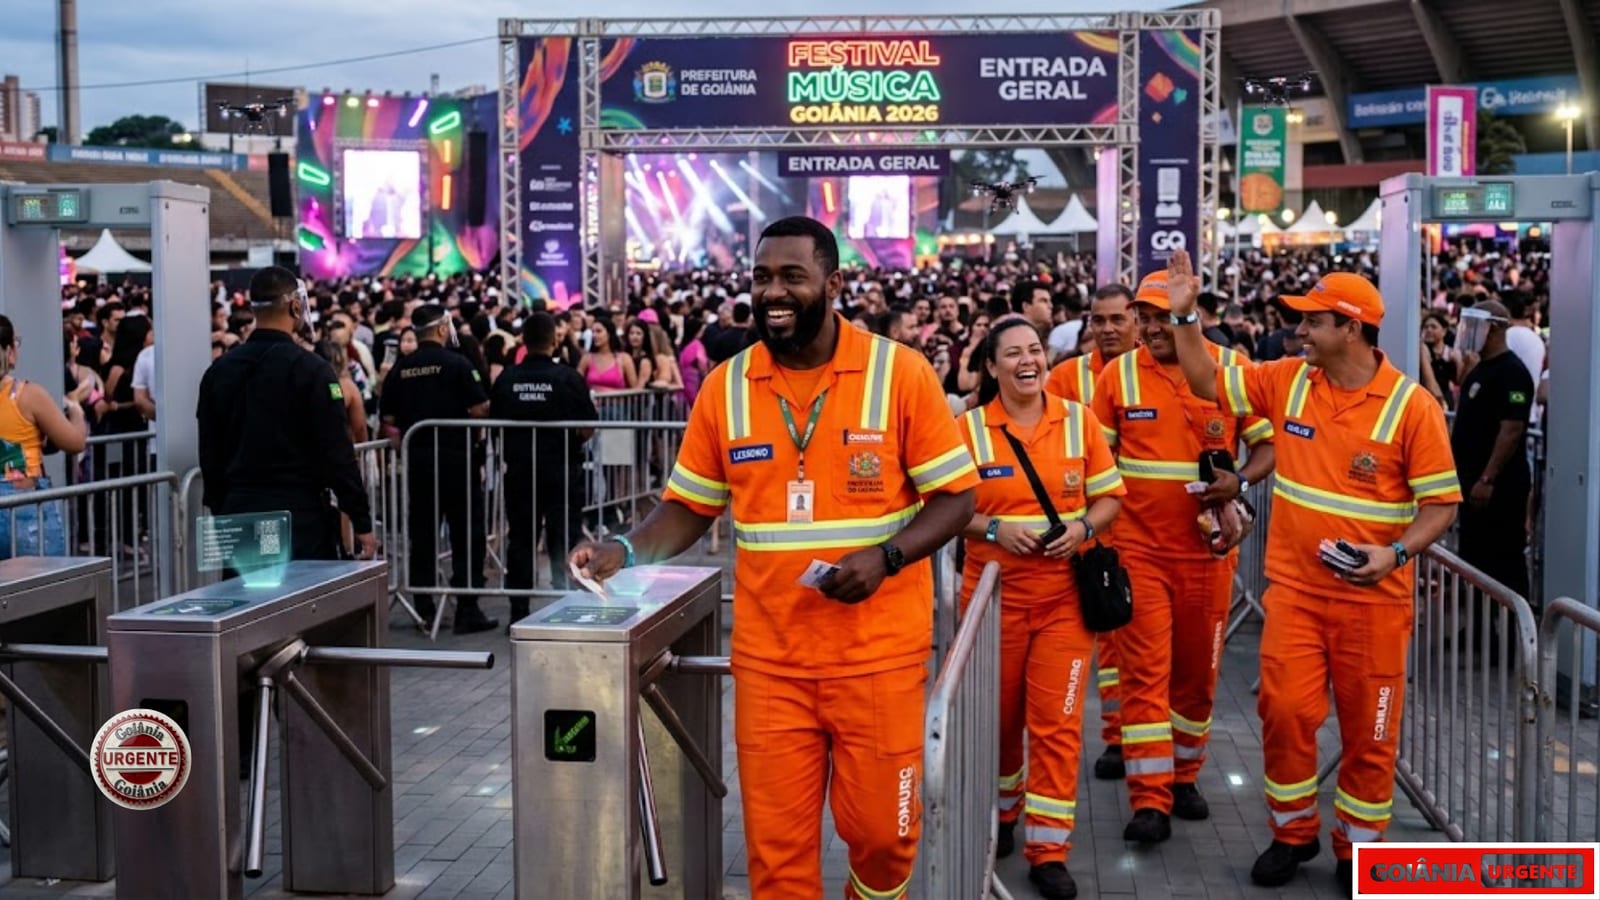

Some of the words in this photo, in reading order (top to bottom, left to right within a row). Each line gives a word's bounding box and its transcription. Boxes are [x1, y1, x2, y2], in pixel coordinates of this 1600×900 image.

[788, 40, 940, 67] FESTIVAL
[680, 69, 758, 81] PREFEITURA
[980, 56, 1107, 77] ENTRADA
[681, 83, 699, 96] DE
[700, 81, 757, 96] GOIÂNIA
[788, 65, 940, 102] MÚSICA
[998, 80, 1088, 101] GERAL
[790, 102, 882, 123] GOIÂNIA
[885, 104, 939, 123] 2026
[788, 156, 875, 171] ENTRADA
[879, 155, 940, 170] GERAL
